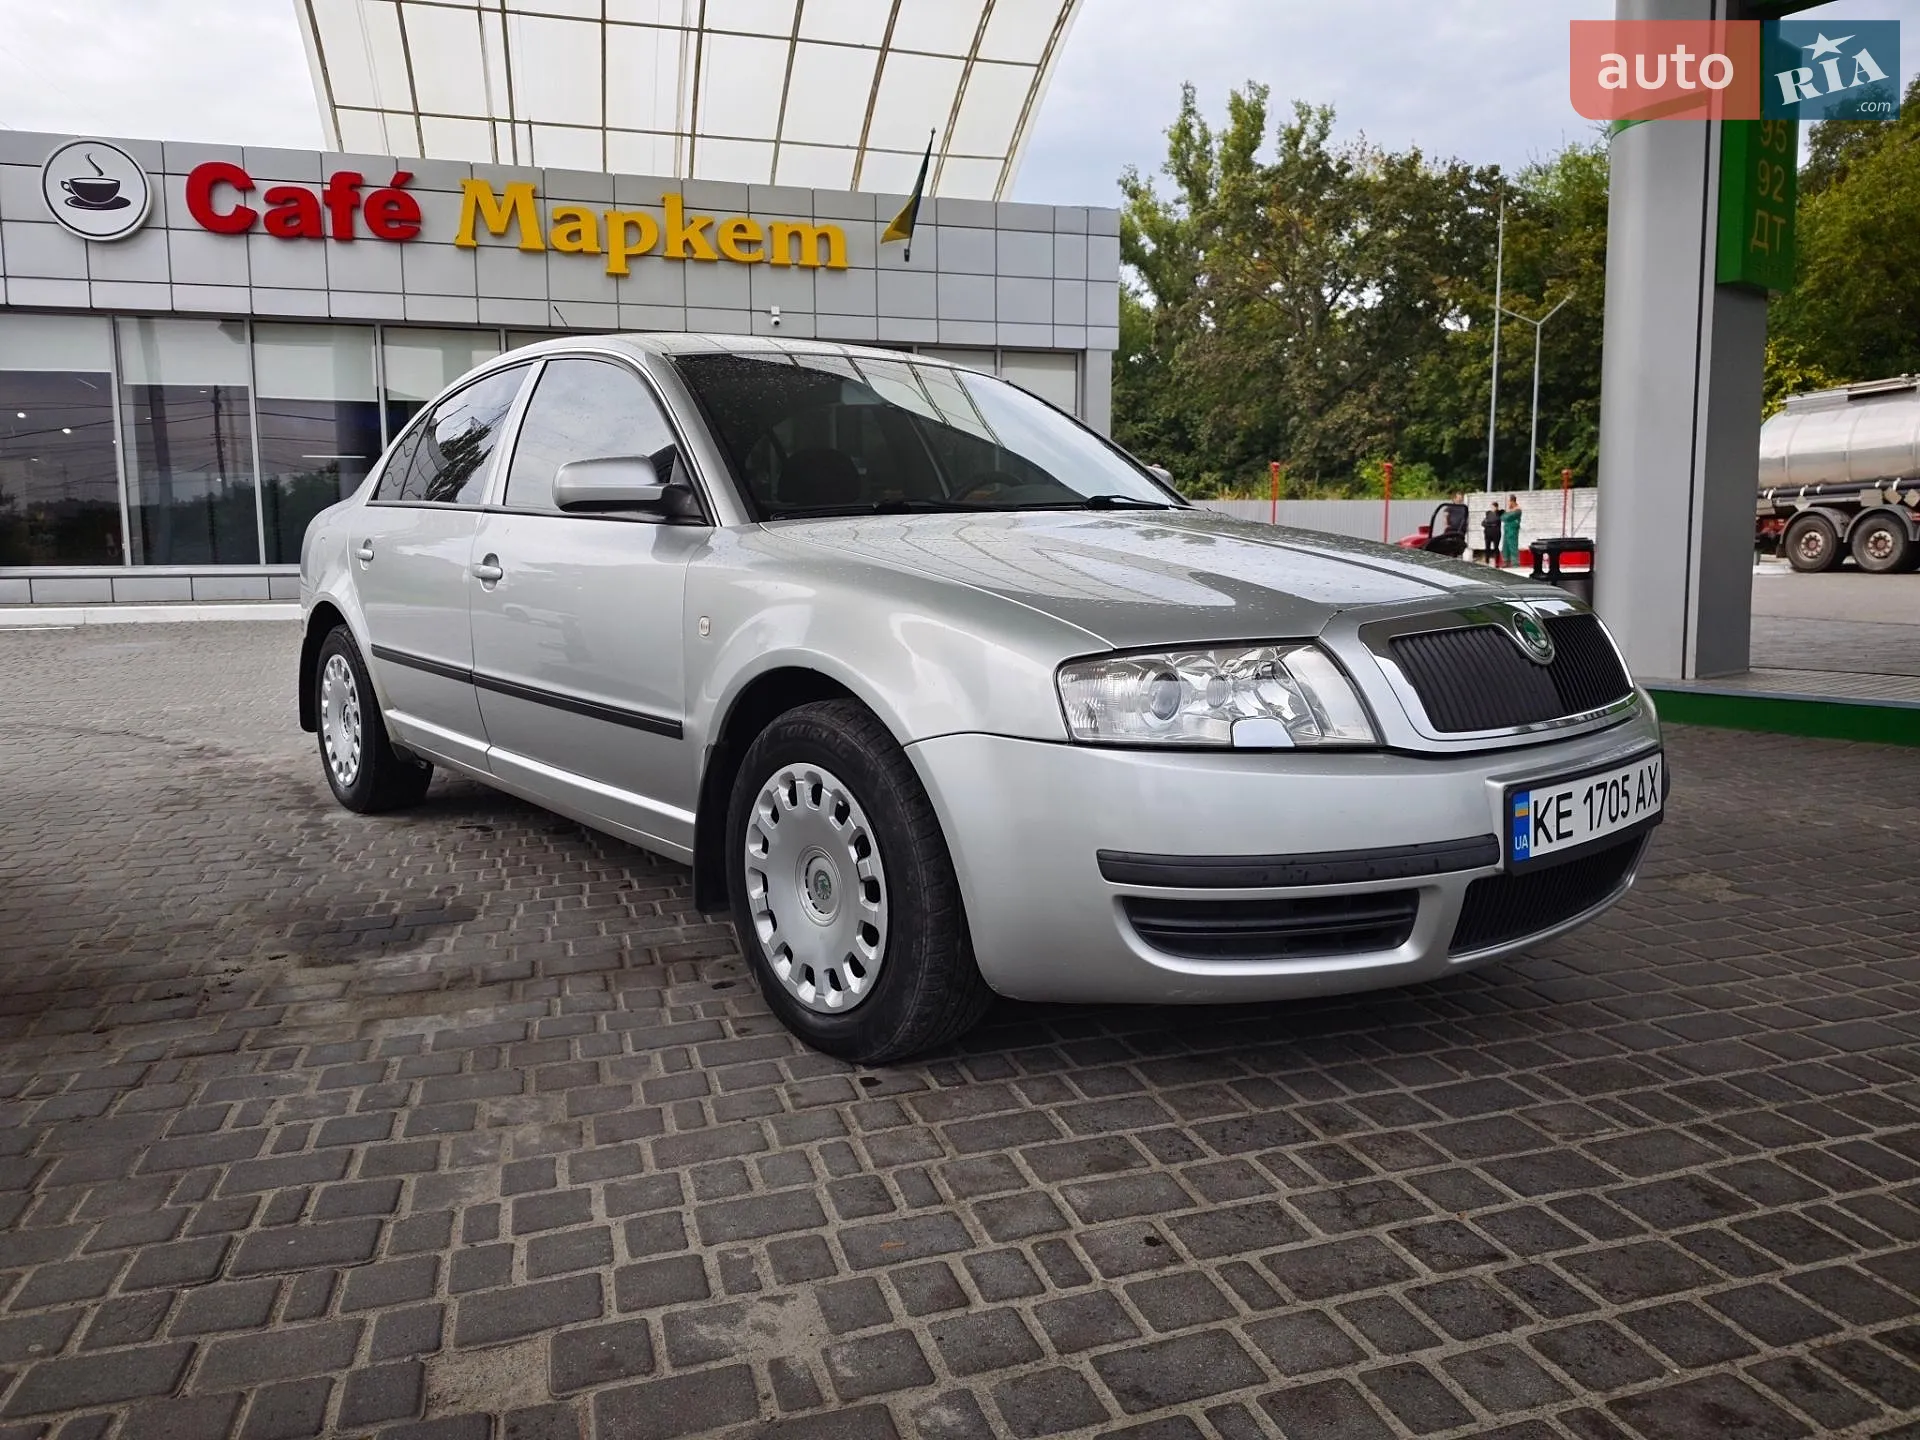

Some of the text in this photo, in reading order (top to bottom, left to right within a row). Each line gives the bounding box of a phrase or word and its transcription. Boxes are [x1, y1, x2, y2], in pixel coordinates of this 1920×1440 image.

[1760, 110, 1787, 153] 95
[186, 161, 422, 241] Café
[1757, 160, 1786, 203] 92
[1751, 209, 1787, 257] ДТ
[1533, 762, 1658, 848] KE 1705 AX
[1514, 834, 1529, 850] UA
